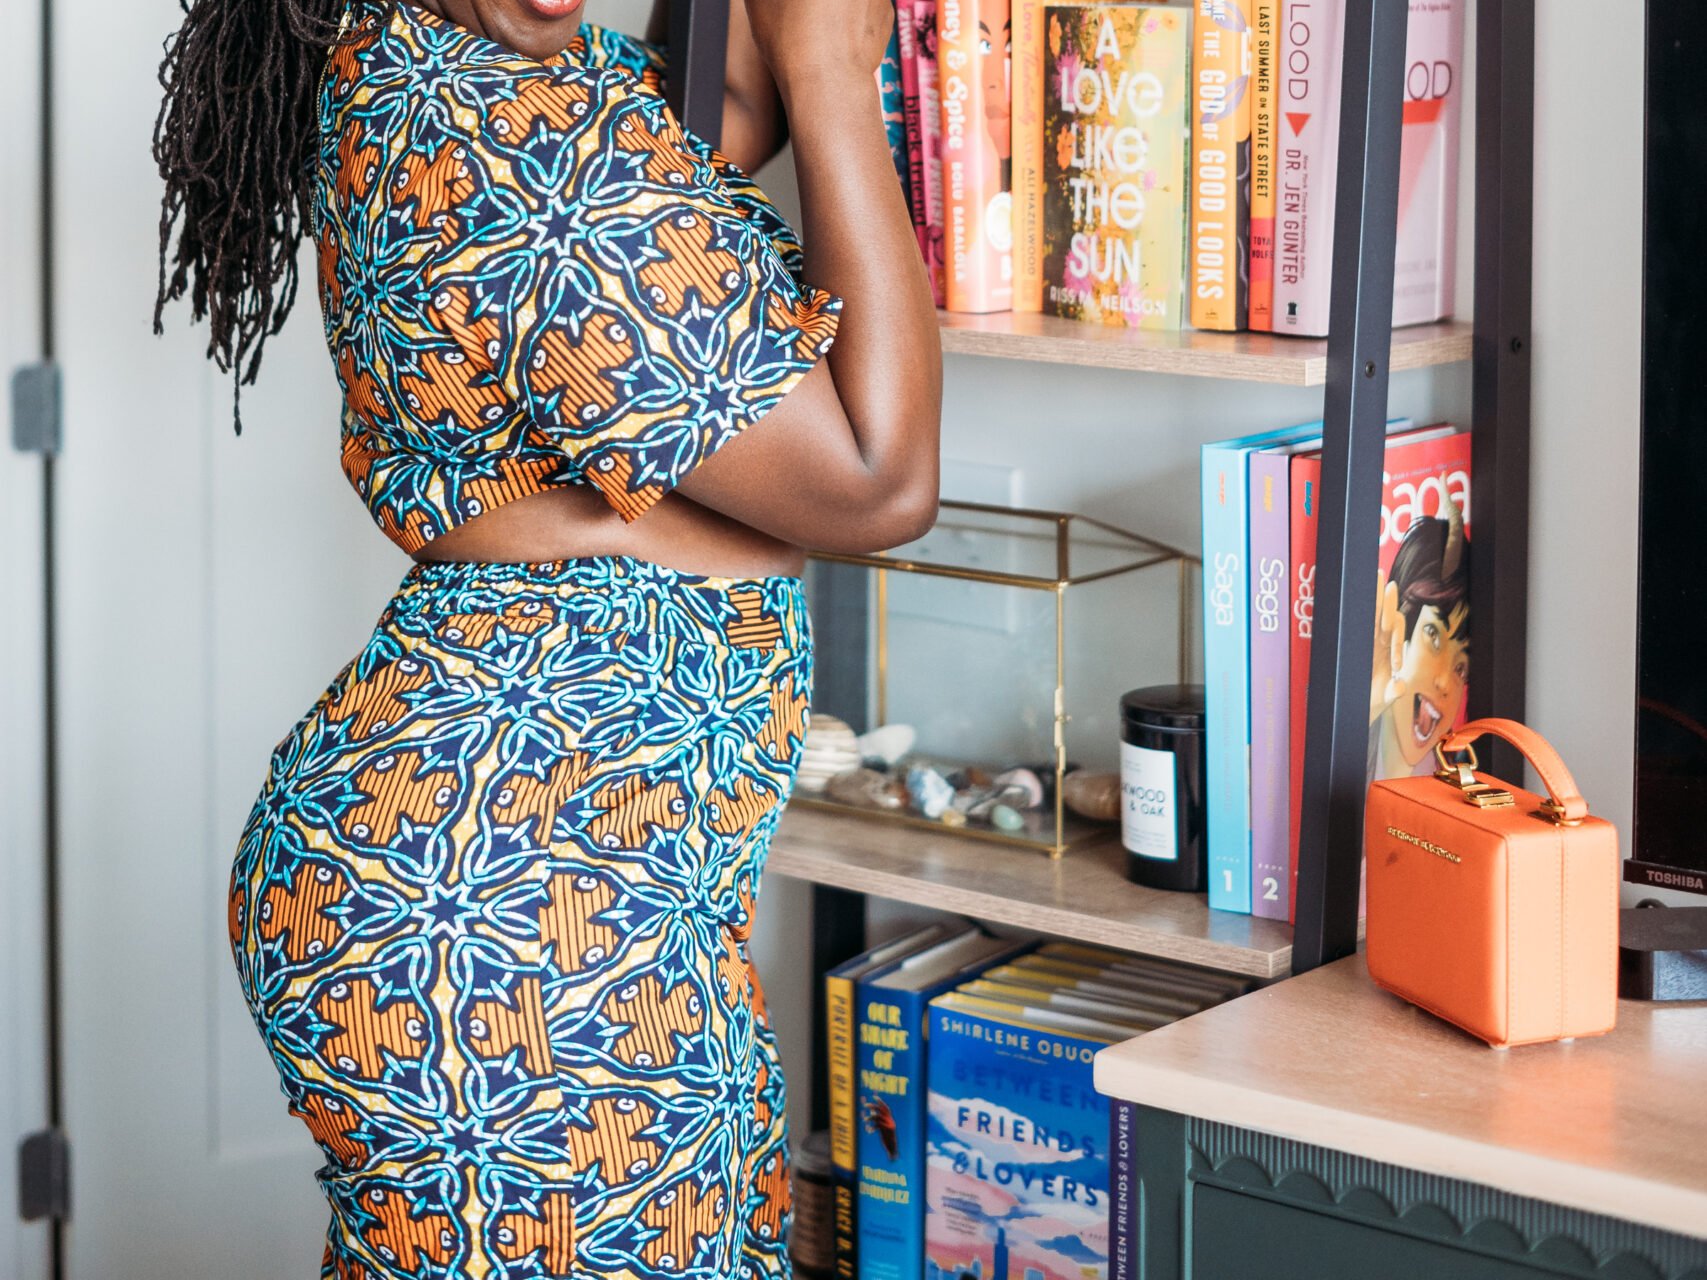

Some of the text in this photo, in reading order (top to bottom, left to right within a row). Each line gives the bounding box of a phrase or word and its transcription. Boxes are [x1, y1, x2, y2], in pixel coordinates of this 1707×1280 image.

[1095, 17, 1121, 60] A
[1257, 6, 1270, 198] LAST SUMMER ON STATE STREET
[1407, 61, 1452, 101] OD
[943, 76, 969, 150] Spice
[904, 95, 927, 226] black friend
[1027, 169, 1035, 189] ALI
[1197, 31, 1226, 299] THE GOD OF GOOD LOOKS
[1026, 192, 1036, 275] HAZELWOOD
[1282, 149, 1301, 284] DR. JEN GUNTER
[1069, 232, 1141, 284] SUN
[1102, 294, 1167, 316] NEILSON
[1210, 552, 1239, 626] Saga
[1255, 557, 1284, 632] Saga
[1294, 563, 1316, 638] Saga
[1141, 803, 1165, 816] OAK
[1223, 870, 1232, 892] 1
[1262, 877, 1278, 900] 2
[1646, 870, 1703, 889] TOSHIBA
[867, 1002, 901, 1027] OUR
[873, 1049, 894, 1071] OF
[941, 1017, 1030, 1051] SHIRLENE
[1037, 1040, 1095, 1064] OBUO
[861, 1069, 909, 1096] NIGHT
[953, 1058, 1100, 1112] BETWEEN
[958, 1106, 1096, 1159] FRIENDS
[1118, 1106, 1129, 1157] LOVERS
[976, 1157, 1098, 1207] LOVERS
[1117, 1174, 1128, 1231] FRIENDS
[1117, 1236, 1128, 1280] TWEEN
